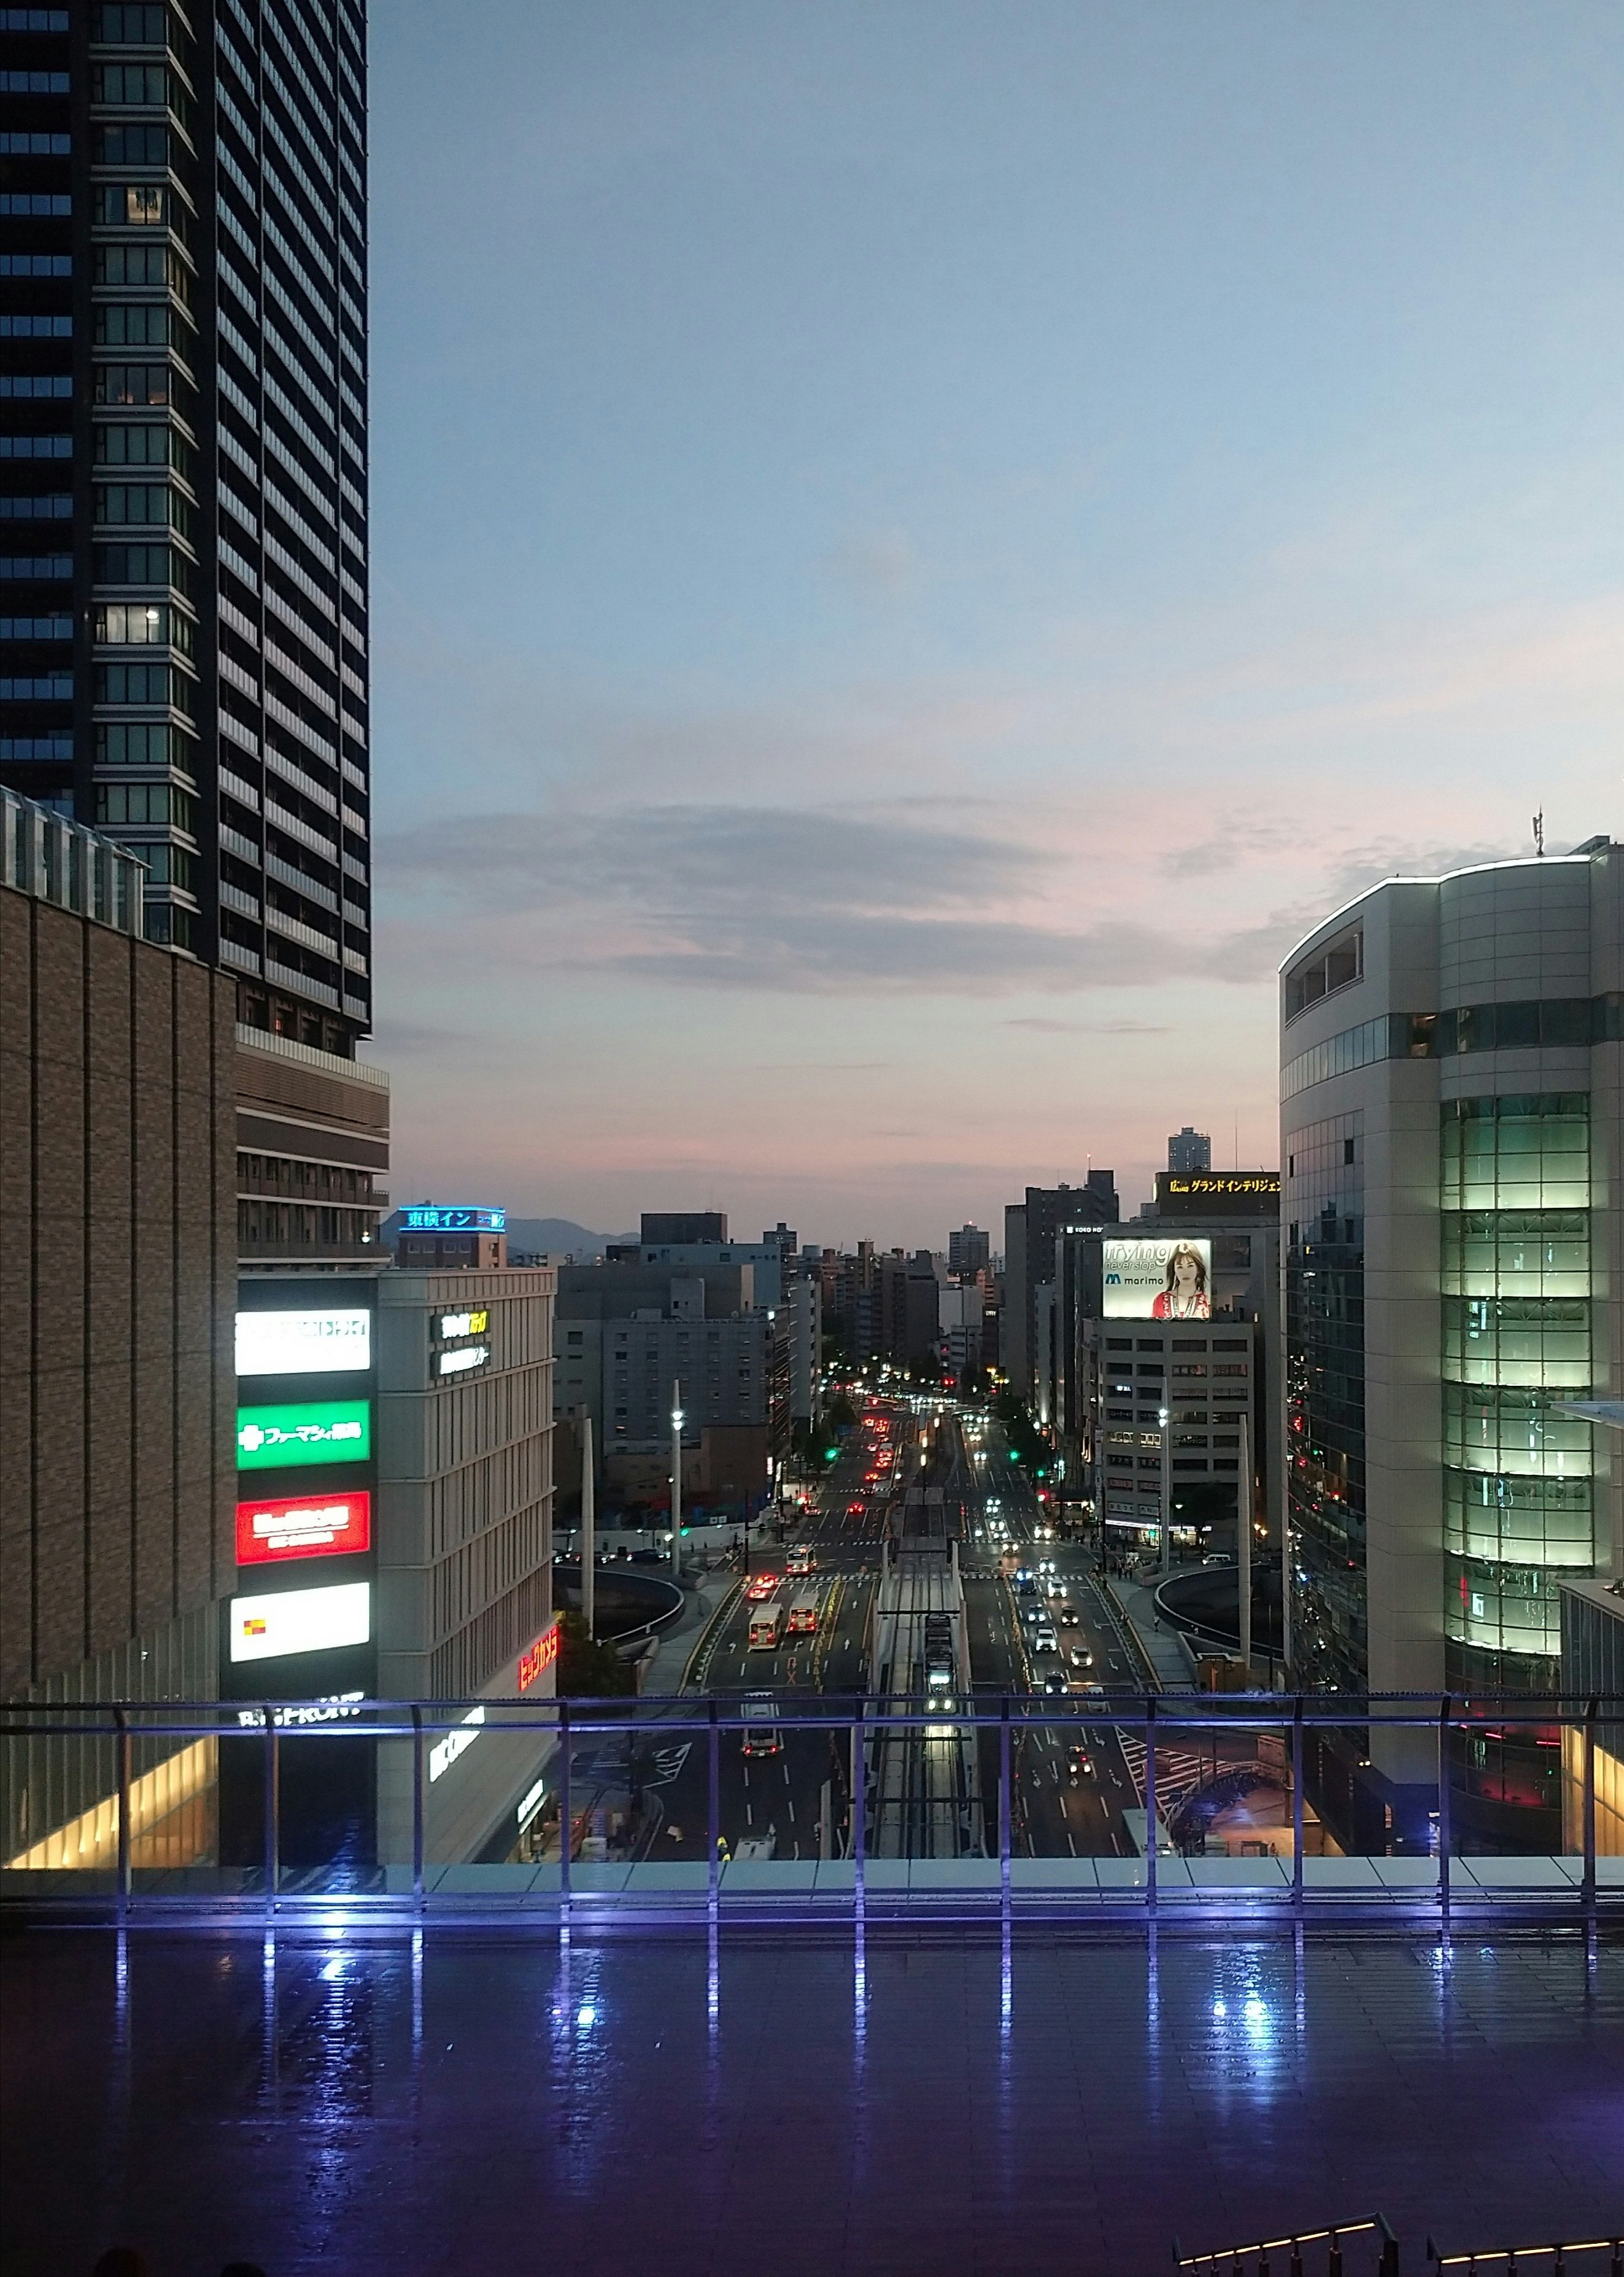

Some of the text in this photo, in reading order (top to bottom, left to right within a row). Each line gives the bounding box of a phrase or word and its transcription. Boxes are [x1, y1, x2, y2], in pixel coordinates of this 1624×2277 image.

[408, 1212, 471, 1227] 東横イン
[1105, 1242, 1170, 1267] trying
[1105, 1261, 1132, 1270] never
[1124, 1276, 1164, 1285] marimo
[519, 1625, 559, 1692] ビックカメラ
